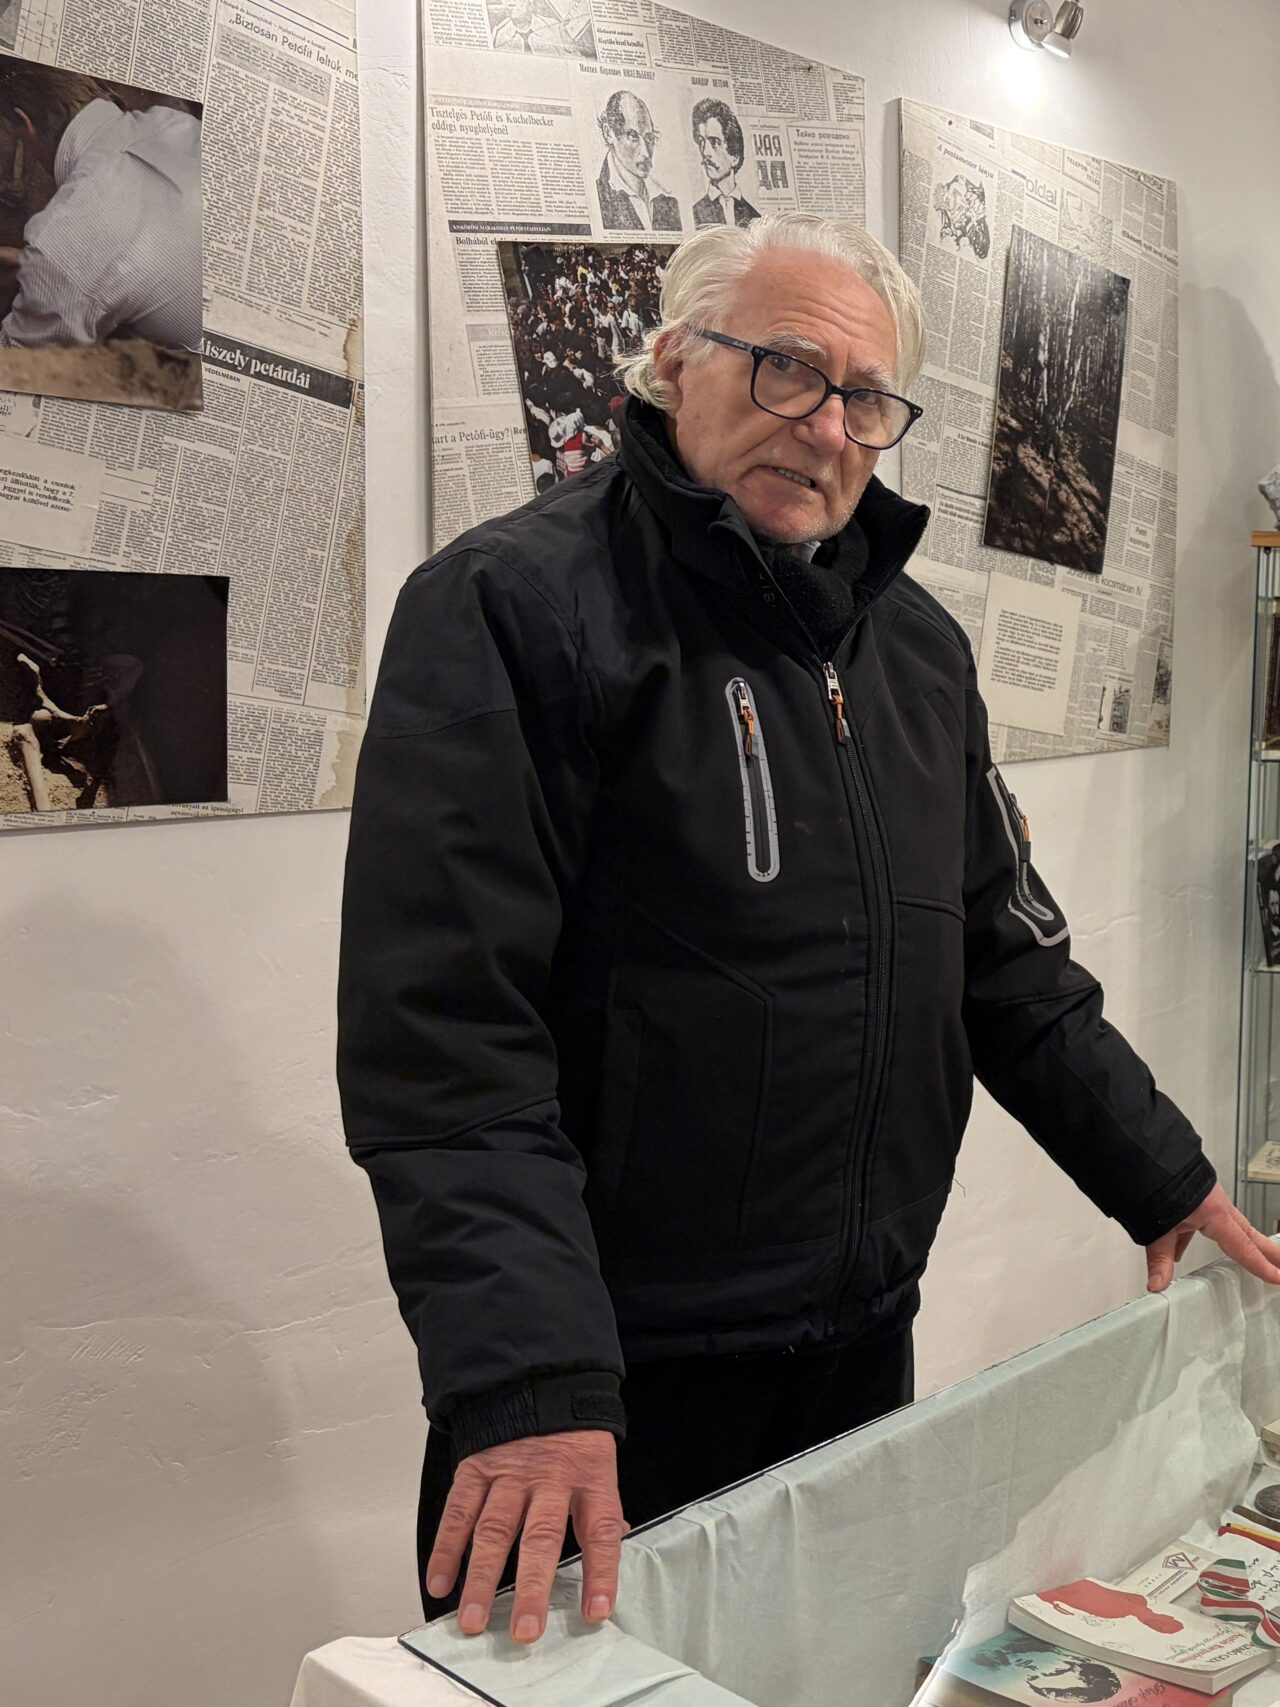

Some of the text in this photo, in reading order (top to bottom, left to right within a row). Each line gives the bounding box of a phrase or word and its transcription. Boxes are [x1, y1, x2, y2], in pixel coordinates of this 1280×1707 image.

[281, 36, 313, 60] Petőfit
[429, 106, 467, 123] Tisztelgés
[470, 109, 493, 123] Petőfi
[495, 112, 504, 123] és
[431, 120, 457, 133] eddigi
[1026, 179, 1058, 206] oldal
[250, 360, 312, 389] petárdái
